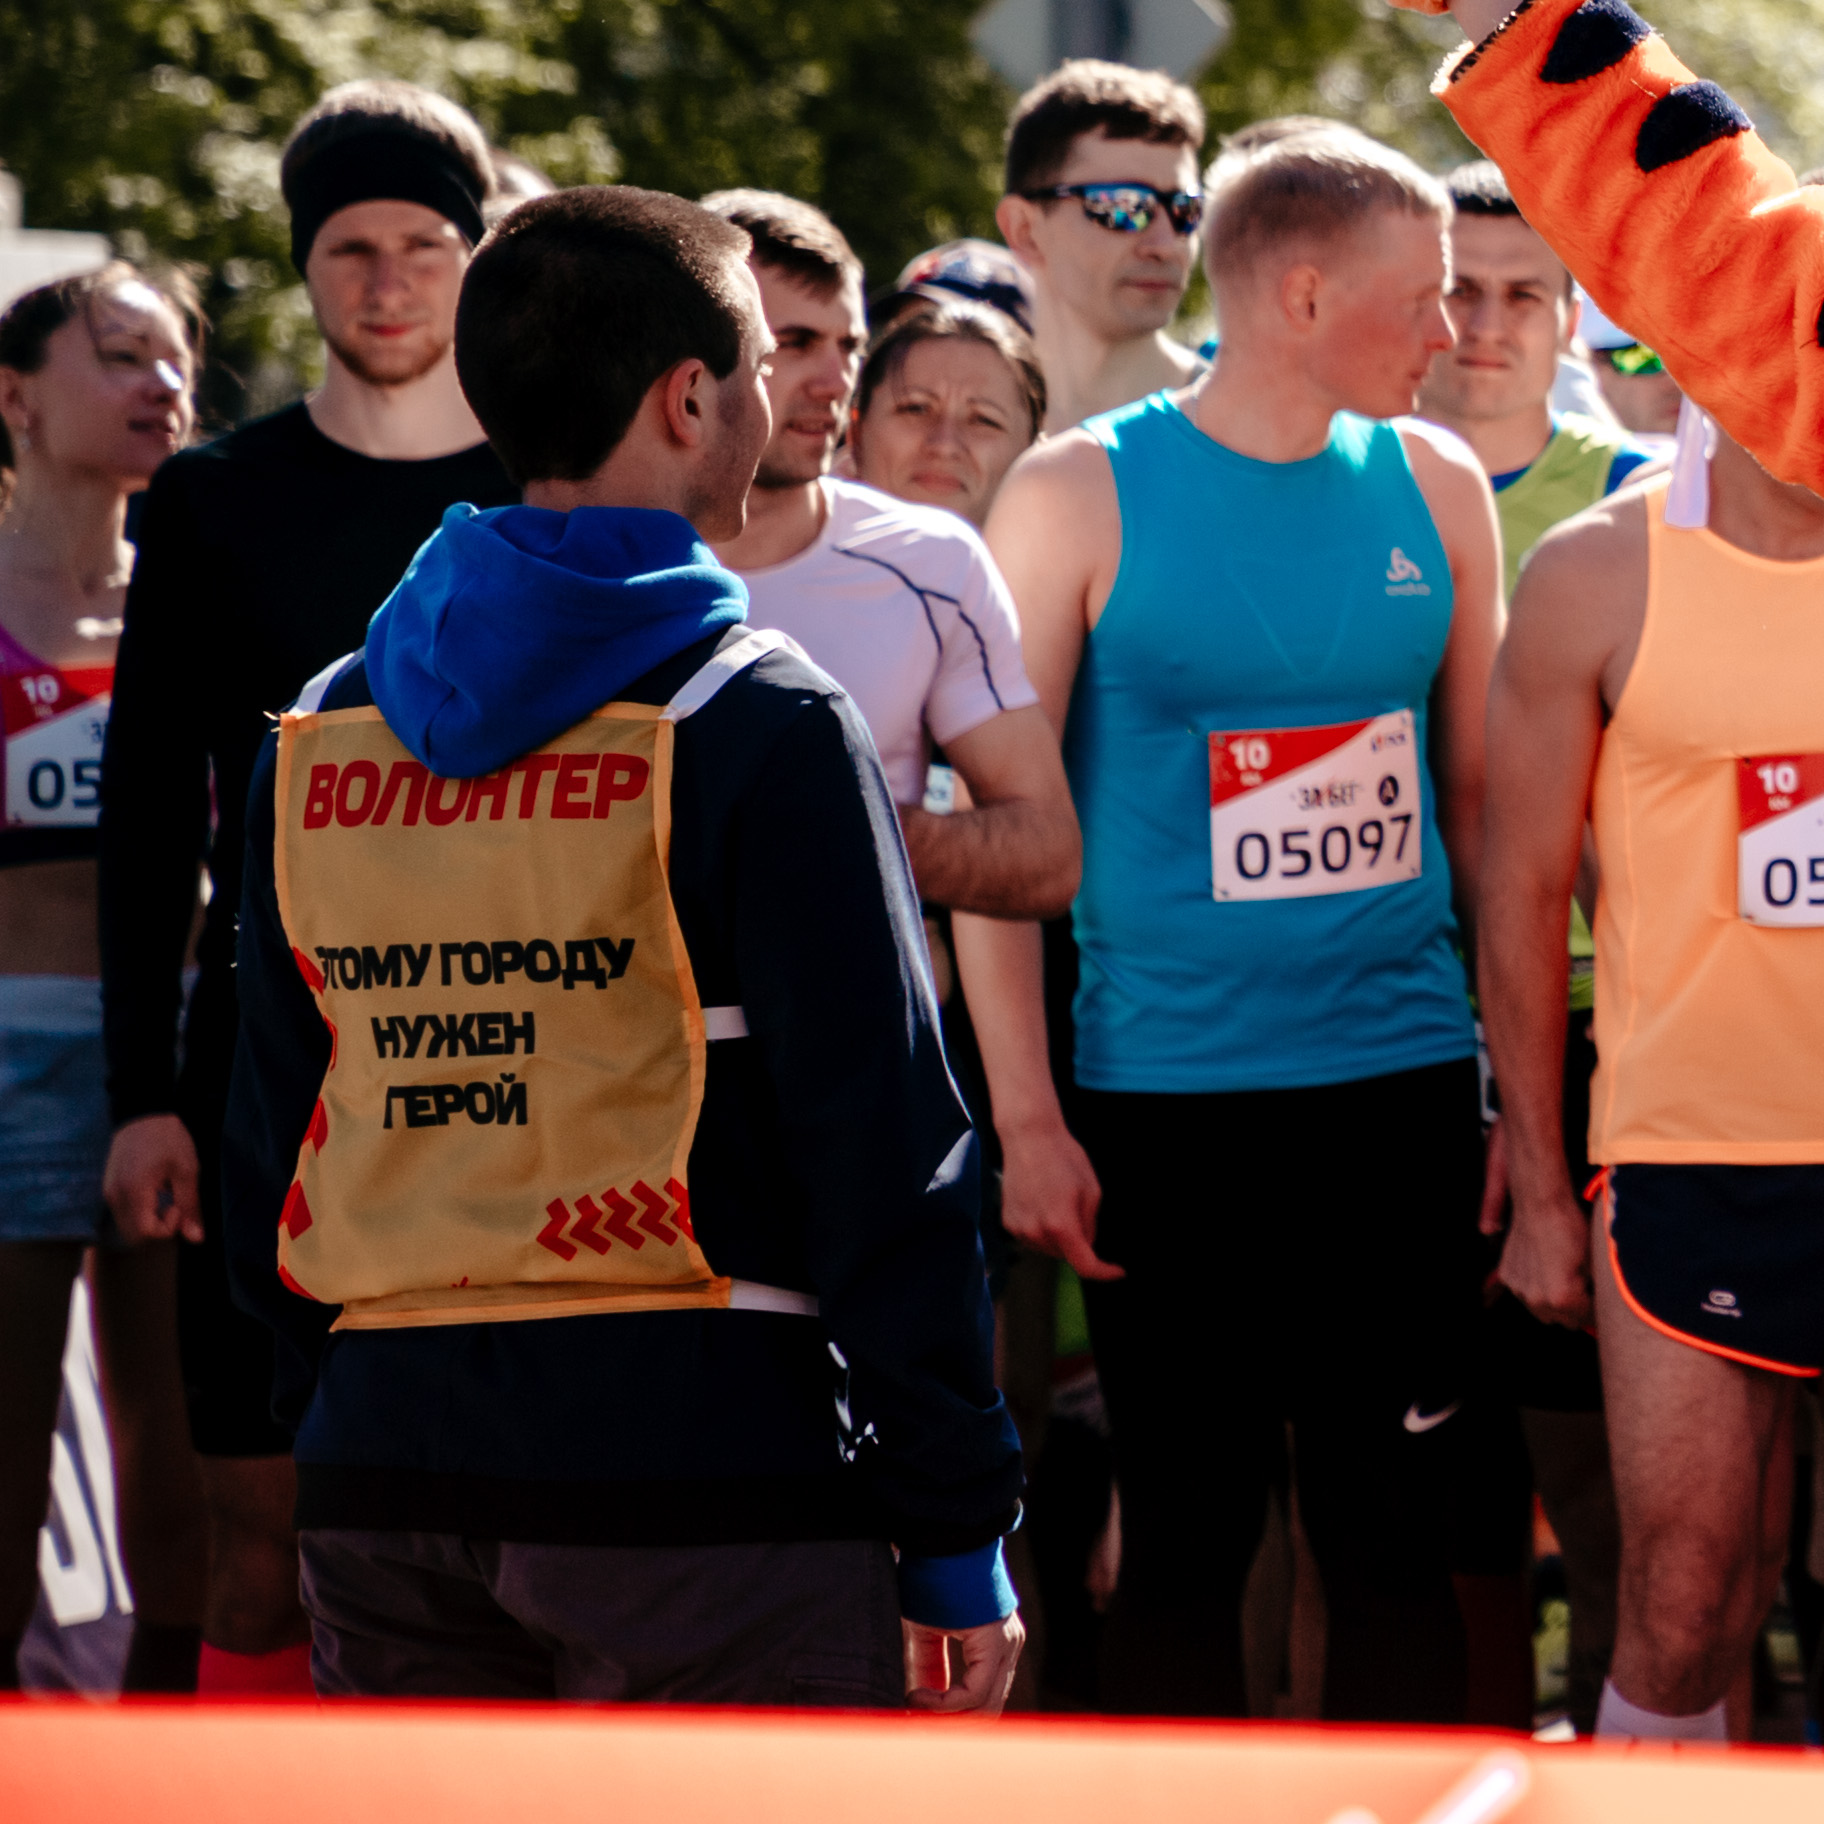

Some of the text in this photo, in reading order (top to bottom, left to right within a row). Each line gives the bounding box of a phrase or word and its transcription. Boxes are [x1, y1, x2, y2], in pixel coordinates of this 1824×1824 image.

[20, 674, 60, 704] 10
[1228, 737, 1271, 770] 10
[1756, 761, 1798, 795] 10
[303, 752, 650, 830] ВОЛОНТЕР
[1236, 813, 1413, 879] 05097
[439, 937, 636, 991] ГОРОДУ
[371, 1011, 536, 1059] НУЖЕН
[383, 1072, 528, 1129] ГЕРОЙ
